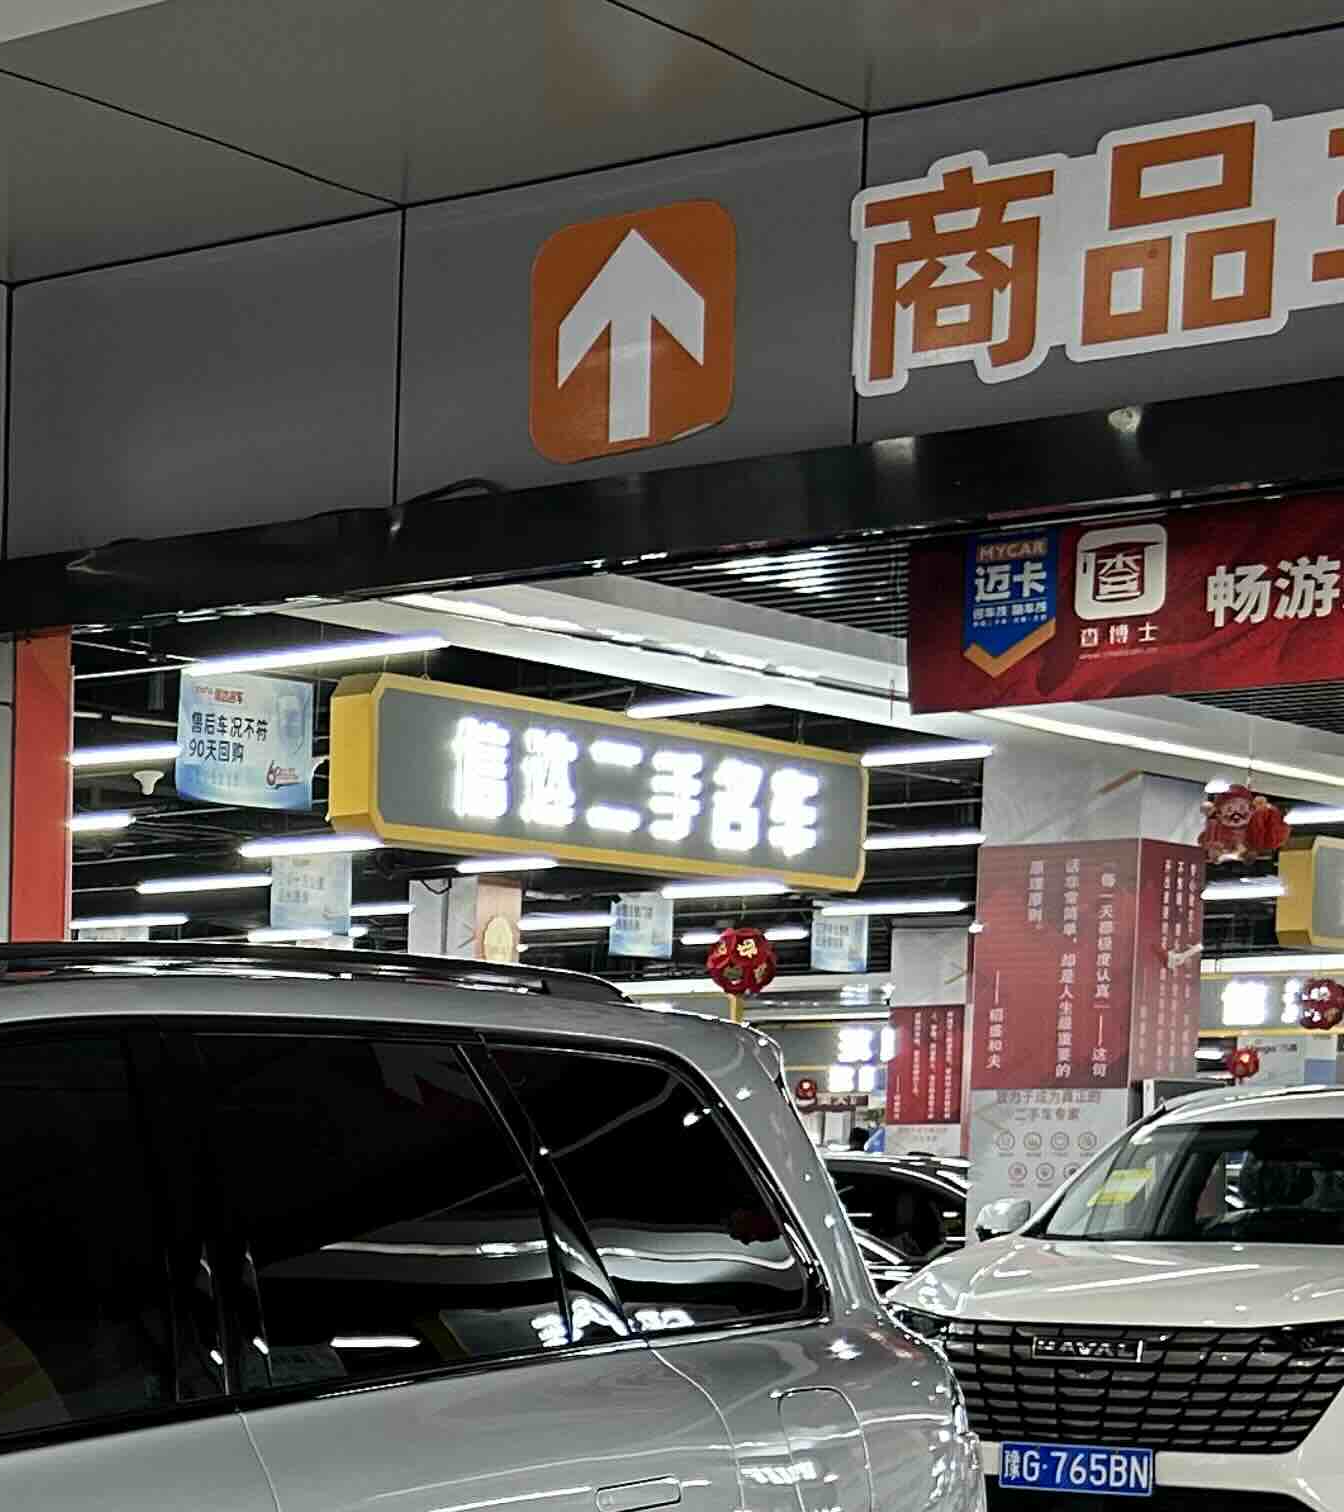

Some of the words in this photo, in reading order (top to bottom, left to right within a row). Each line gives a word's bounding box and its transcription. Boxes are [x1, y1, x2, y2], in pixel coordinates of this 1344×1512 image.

[853, 105, 1344, 395] 商品
[978, 540, 1049, 562] MYCAR
[975, 560, 1048, 602] 迈卡
[1080, 621, 1160, 649] 查博士
[191, 711, 269, 741] 售后车况不符
[188, 738, 245, 763] 90天回购
[1037, 1339, 1135, 1358] HAVAL
